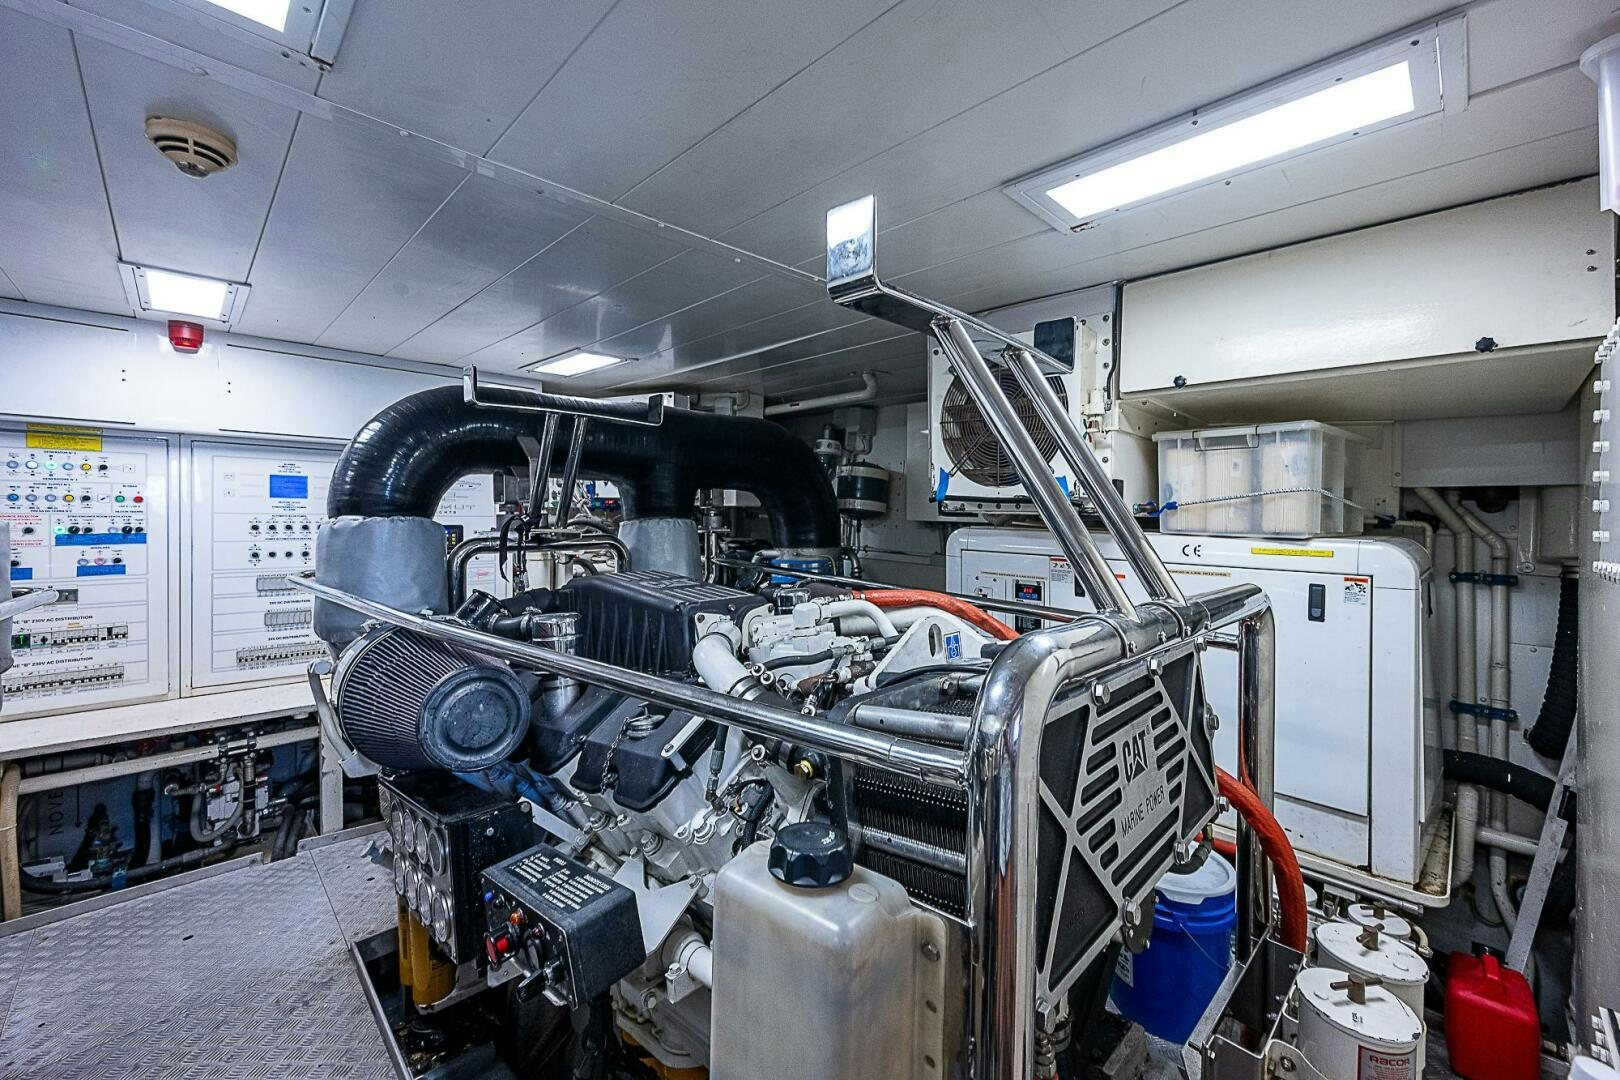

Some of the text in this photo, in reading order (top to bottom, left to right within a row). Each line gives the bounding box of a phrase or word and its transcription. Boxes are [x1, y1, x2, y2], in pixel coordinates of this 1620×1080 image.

[55, 656, 93, 664] DISTRIBUTION
[1122, 728, 1149, 784] CAT
[1120, 785, 1165, 838] MARINE POWER
